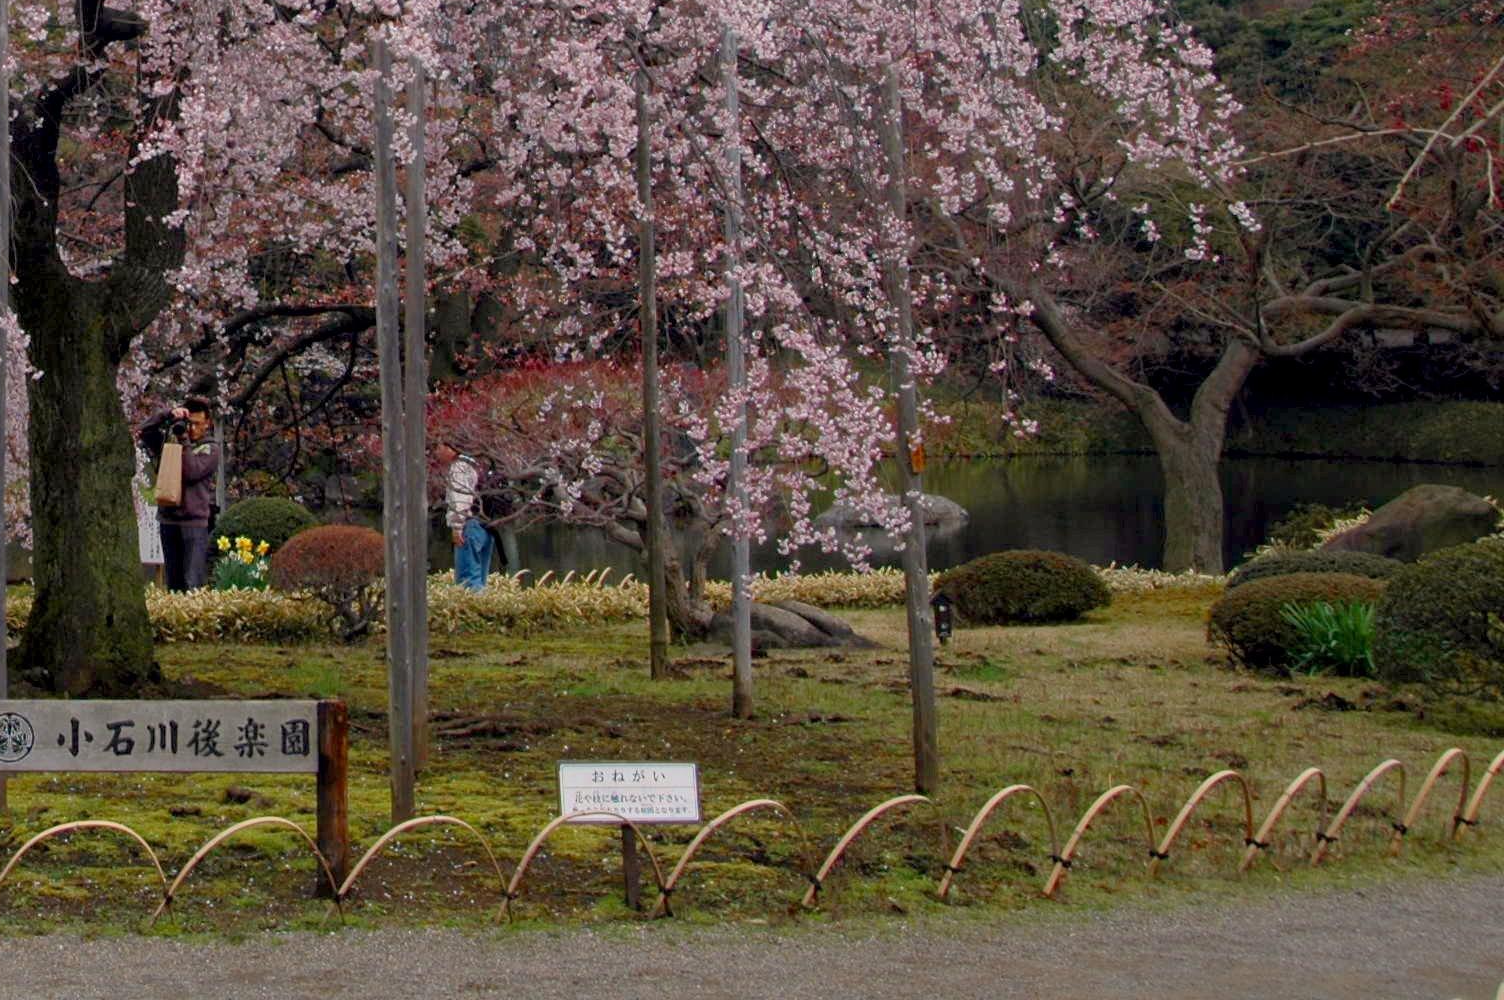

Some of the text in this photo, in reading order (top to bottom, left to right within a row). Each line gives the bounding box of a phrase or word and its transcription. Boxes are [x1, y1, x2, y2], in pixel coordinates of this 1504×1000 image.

[56, 716, 312, 758] 小石川後楽園
[591, 768, 667, 784] おねがい
